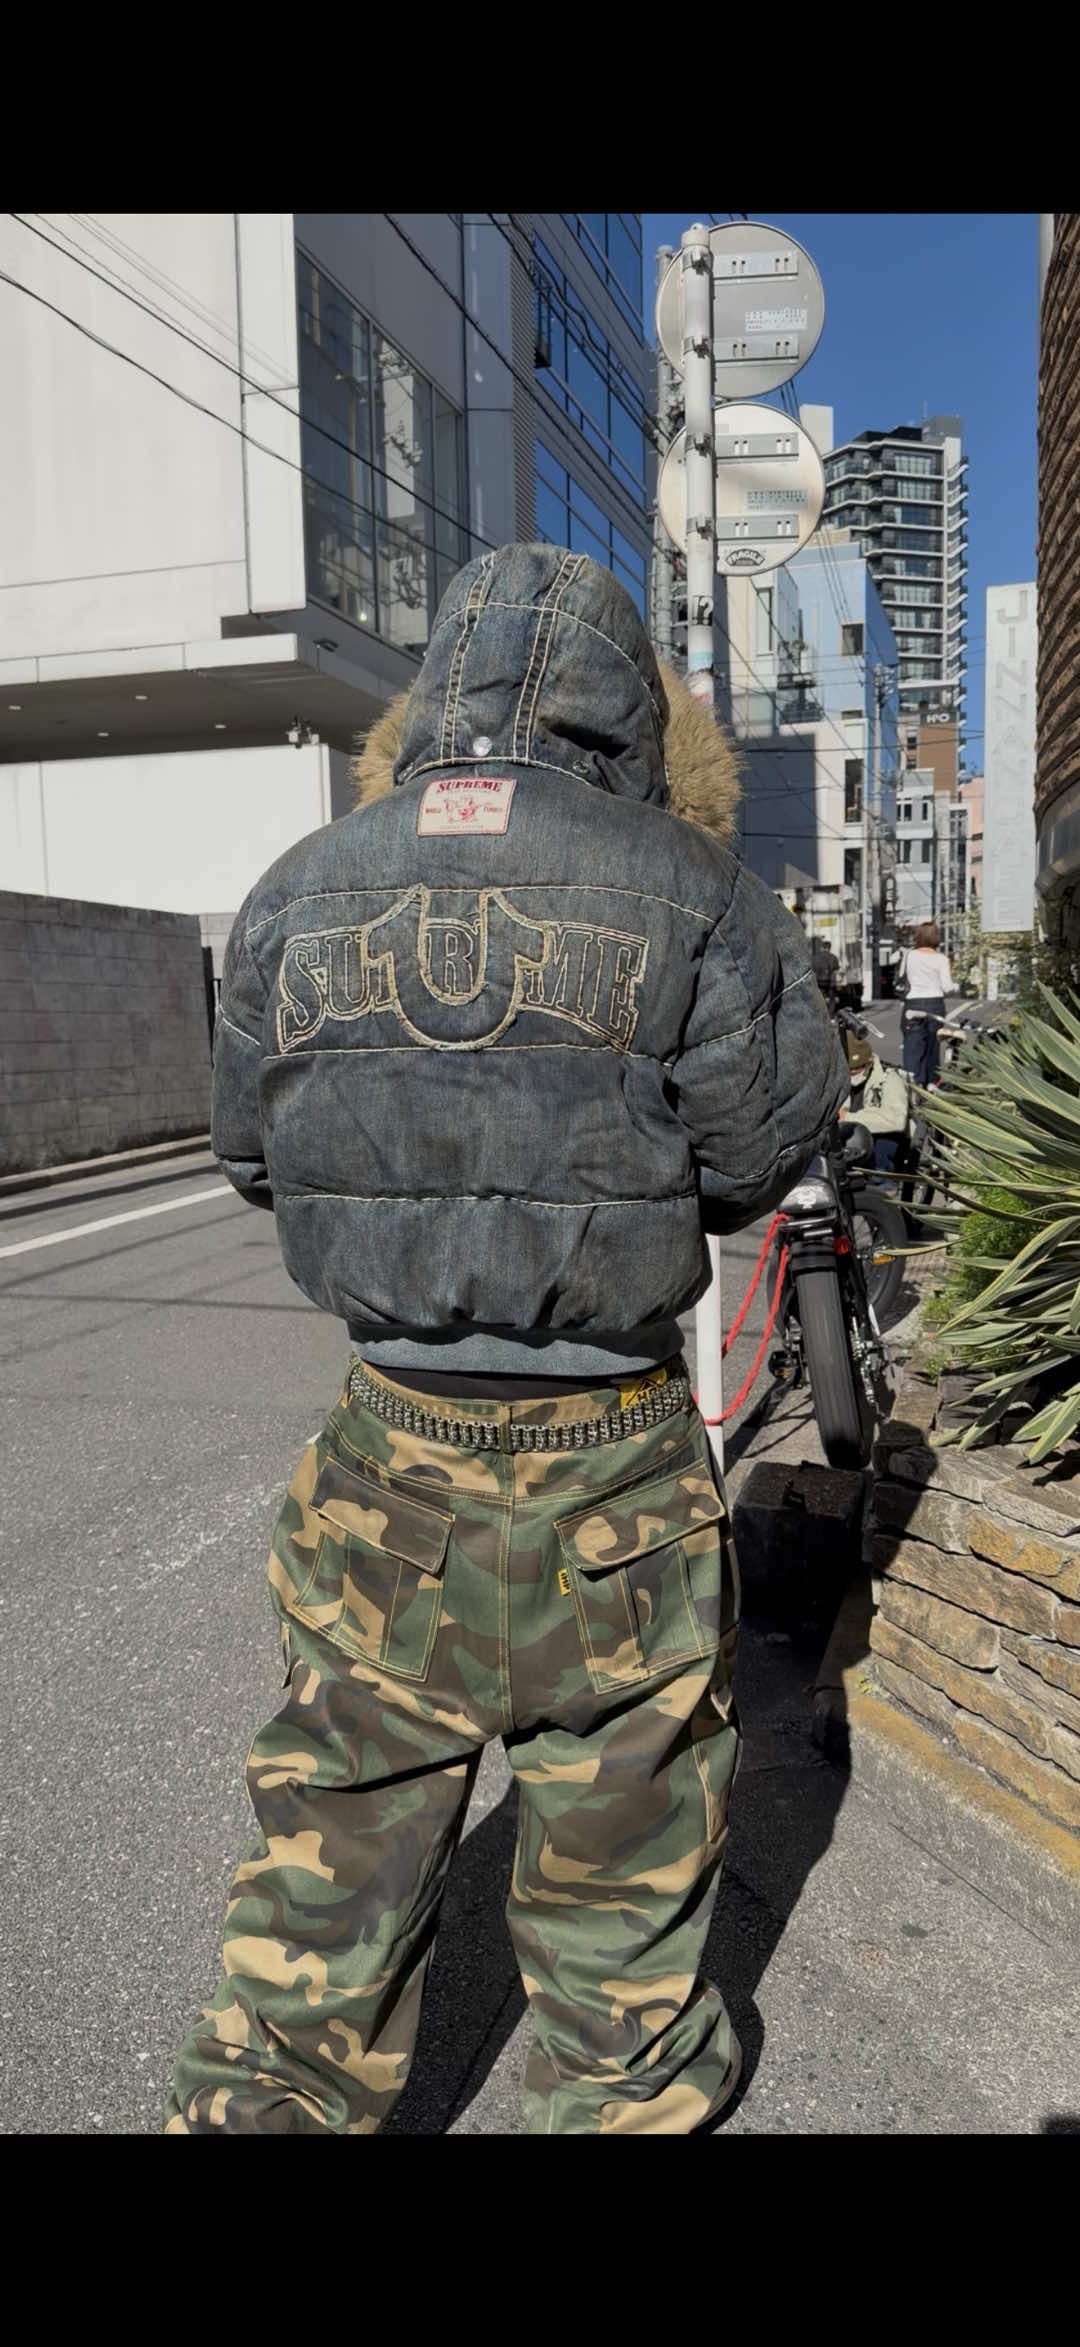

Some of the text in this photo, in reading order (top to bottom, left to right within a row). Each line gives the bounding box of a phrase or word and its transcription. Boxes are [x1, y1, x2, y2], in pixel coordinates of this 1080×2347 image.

[727, 550, 761, 565] FRAGILE
[436, 780, 503, 793] SUPREME
[276, 917, 650, 1055] SURME
